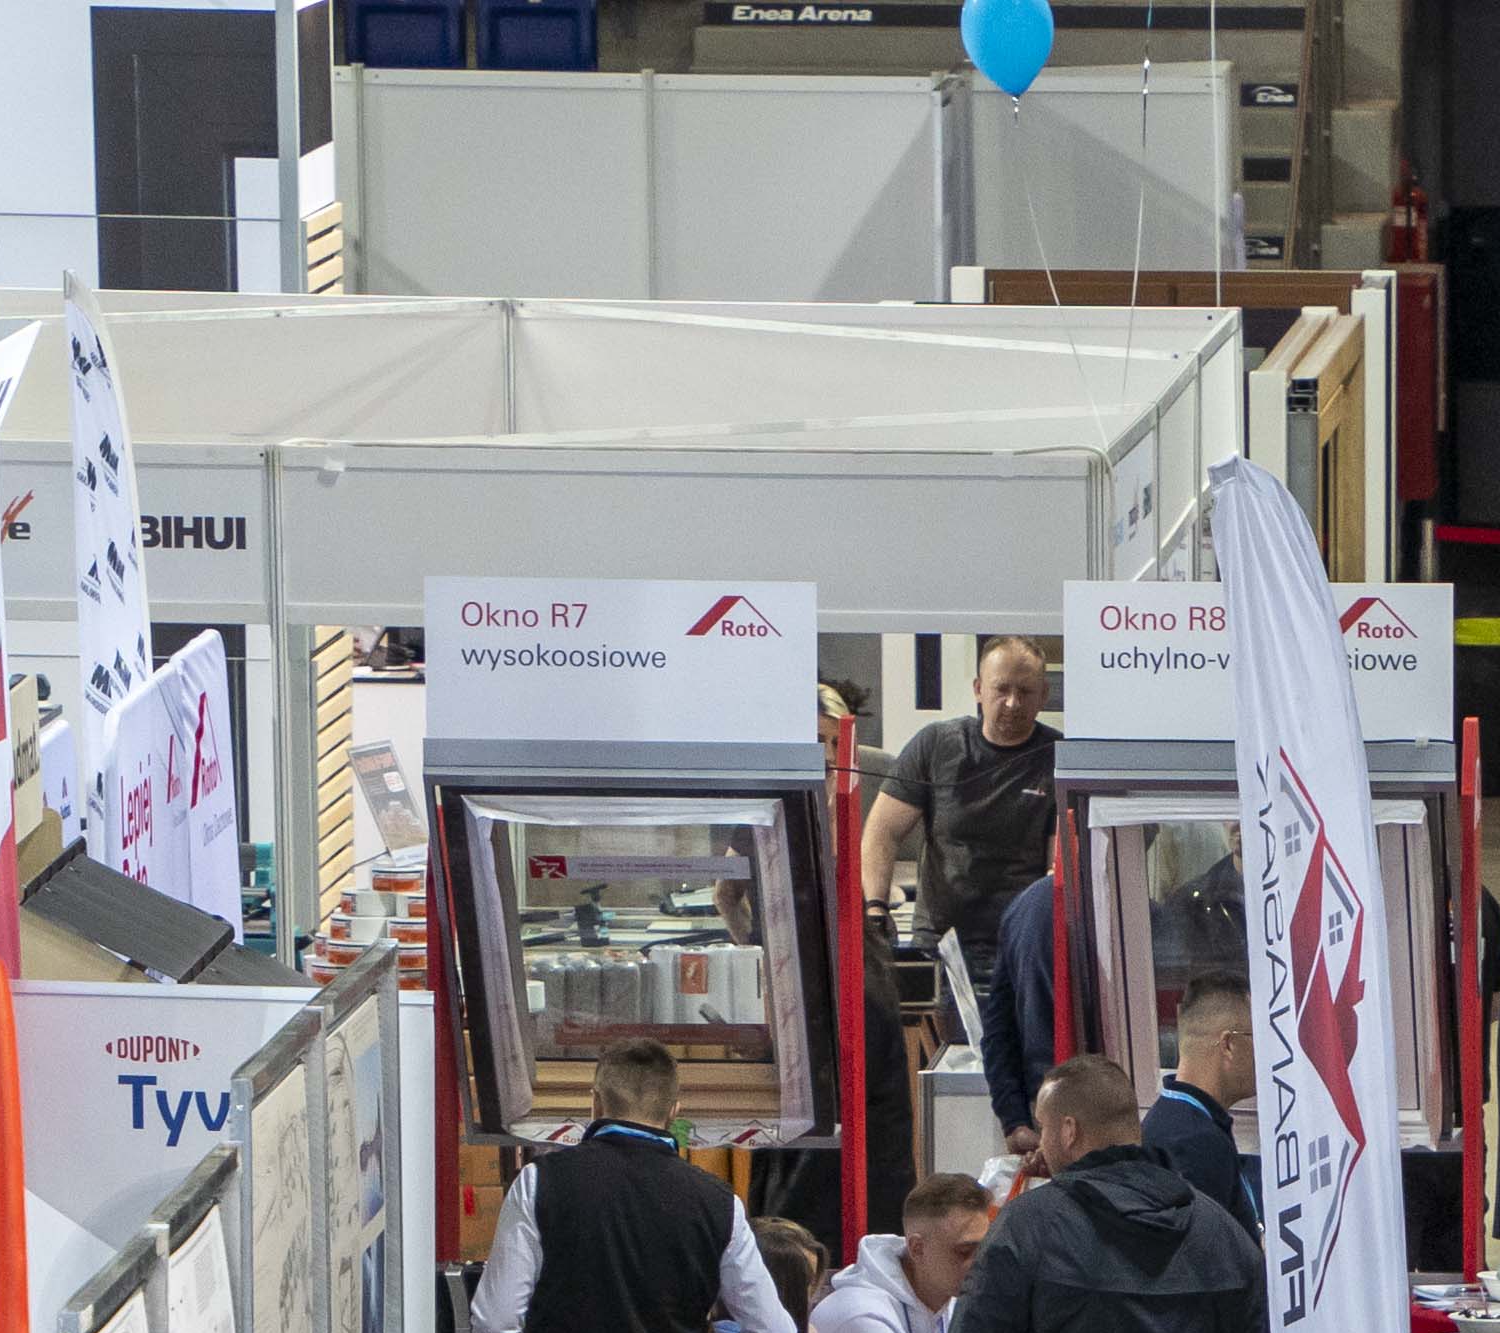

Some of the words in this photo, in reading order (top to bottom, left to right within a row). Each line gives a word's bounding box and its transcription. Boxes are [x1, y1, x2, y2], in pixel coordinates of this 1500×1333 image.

[732, 5, 795, 22] Enea
[799, 5, 874, 22] Arena
[460, 601, 540, 628] Okno
[550, 602, 589, 629] R7
[720, 619, 770, 638] Roto
[1099, 605, 1177, 632] Okno
[1188, 606, 1227, 632] R8
[1356, 621, 1405, 639] Roto
[460, 642, 668, 672] wysokoosiowe
[117, 1036, 191, 1063] DUPONT
